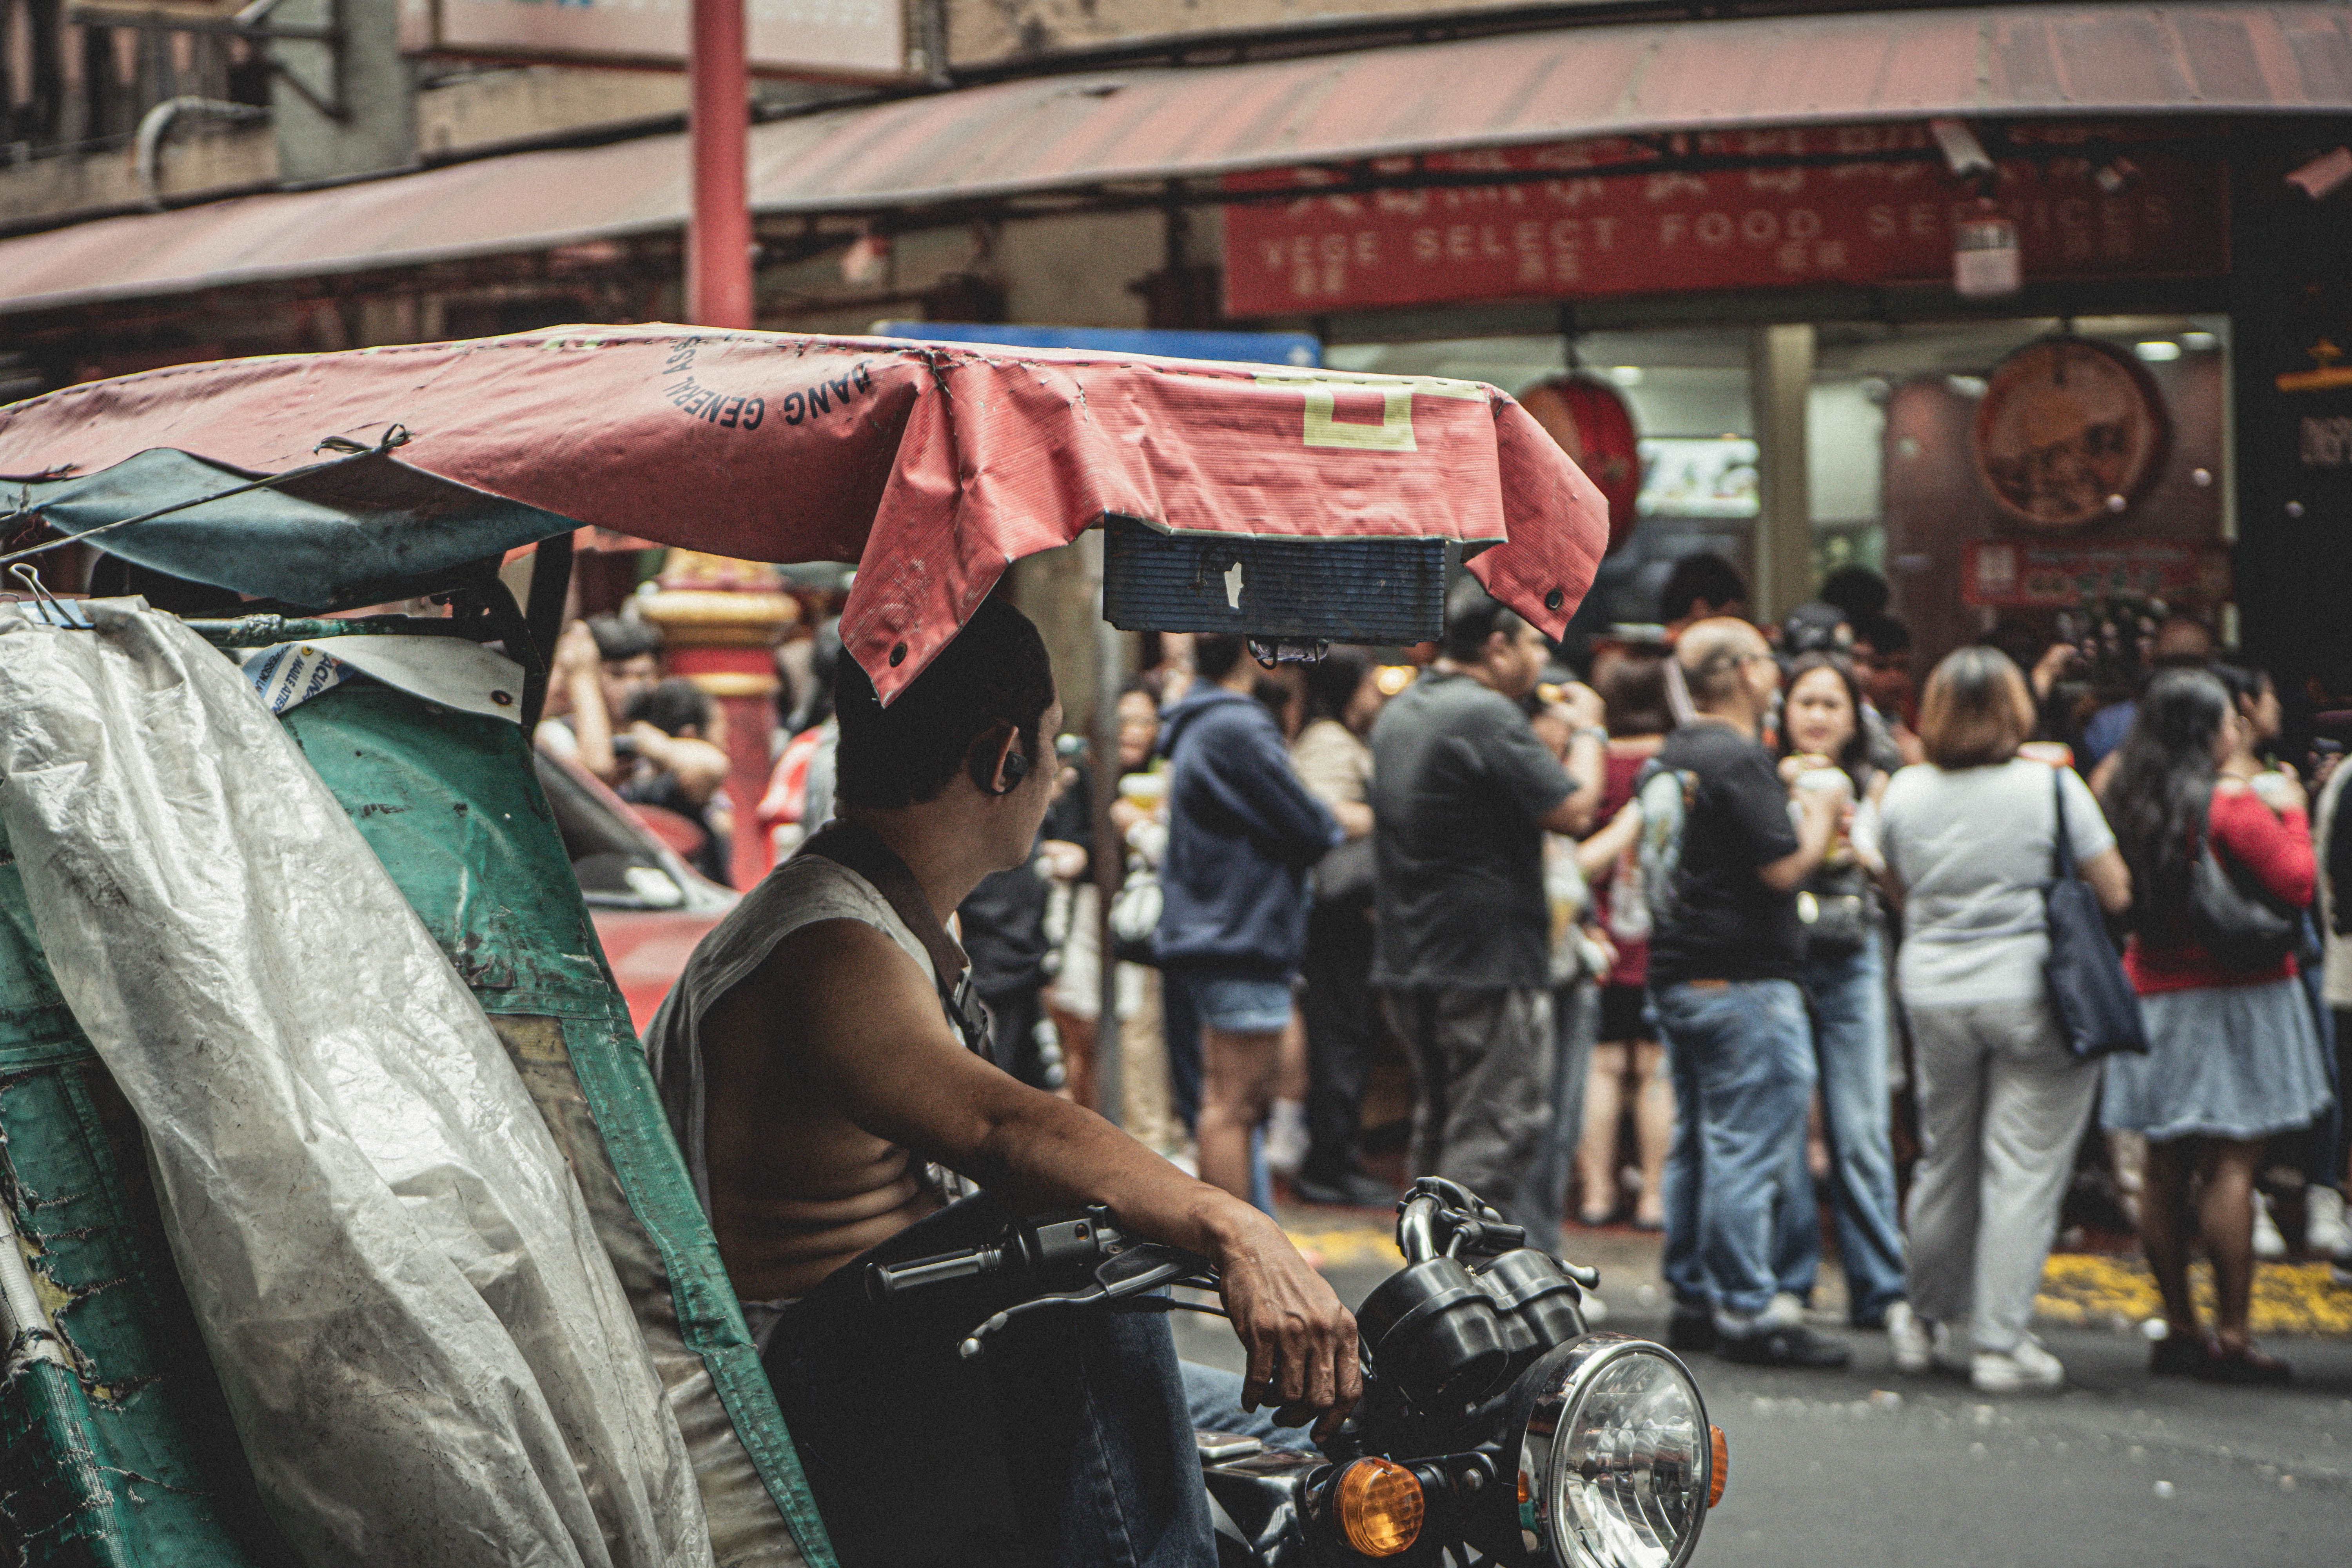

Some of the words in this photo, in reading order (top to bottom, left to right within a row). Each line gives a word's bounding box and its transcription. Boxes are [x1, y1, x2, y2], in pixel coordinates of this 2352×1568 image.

[1414, 216, 1618, 260] SELECT
[1659, 207, 1823, 246] FOOD
[663, 376, 765, 430] GENERAL
[285, 655, 304, 687] MAILE
